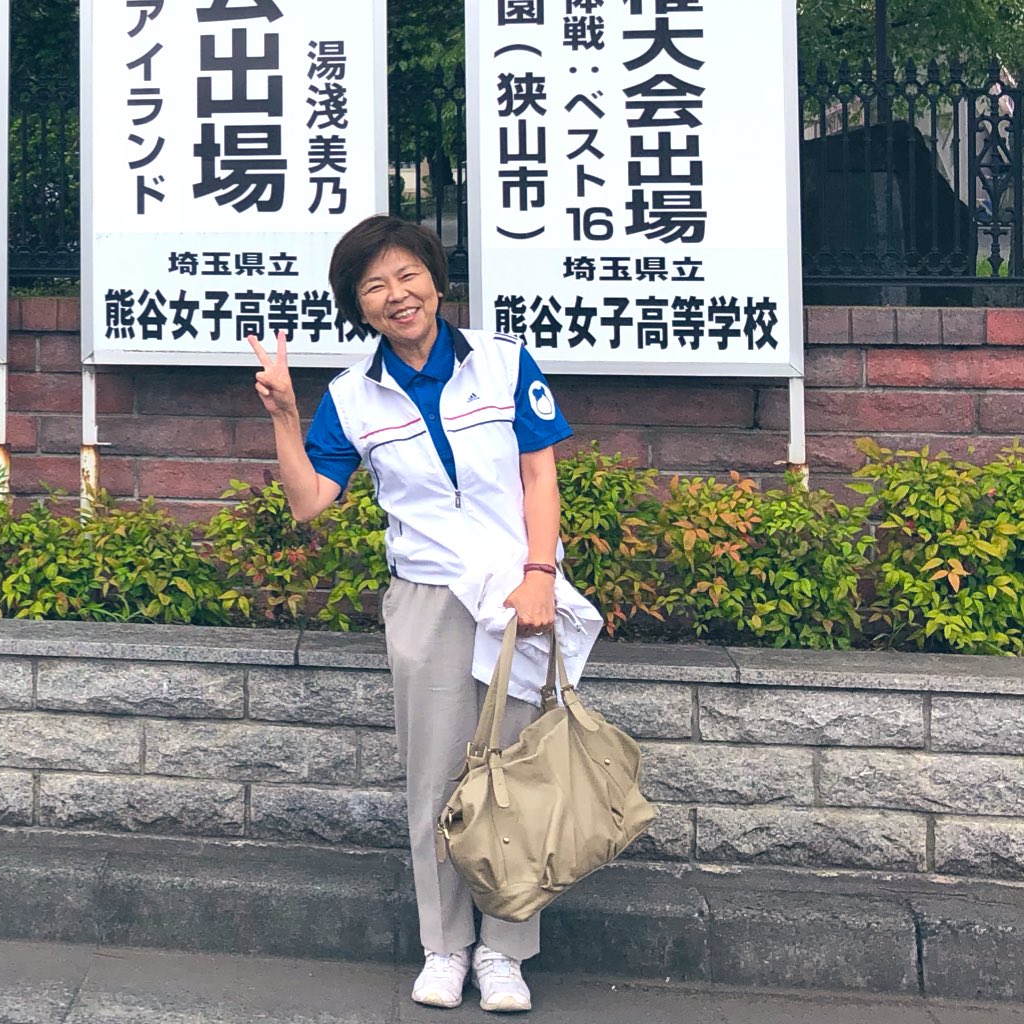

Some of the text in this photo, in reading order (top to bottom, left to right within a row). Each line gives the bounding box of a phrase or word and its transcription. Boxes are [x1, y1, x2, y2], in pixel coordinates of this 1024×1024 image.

[168, 252, 299, 276] 埼玉県立
[563, 256, 704, 281] 埼玉県立
